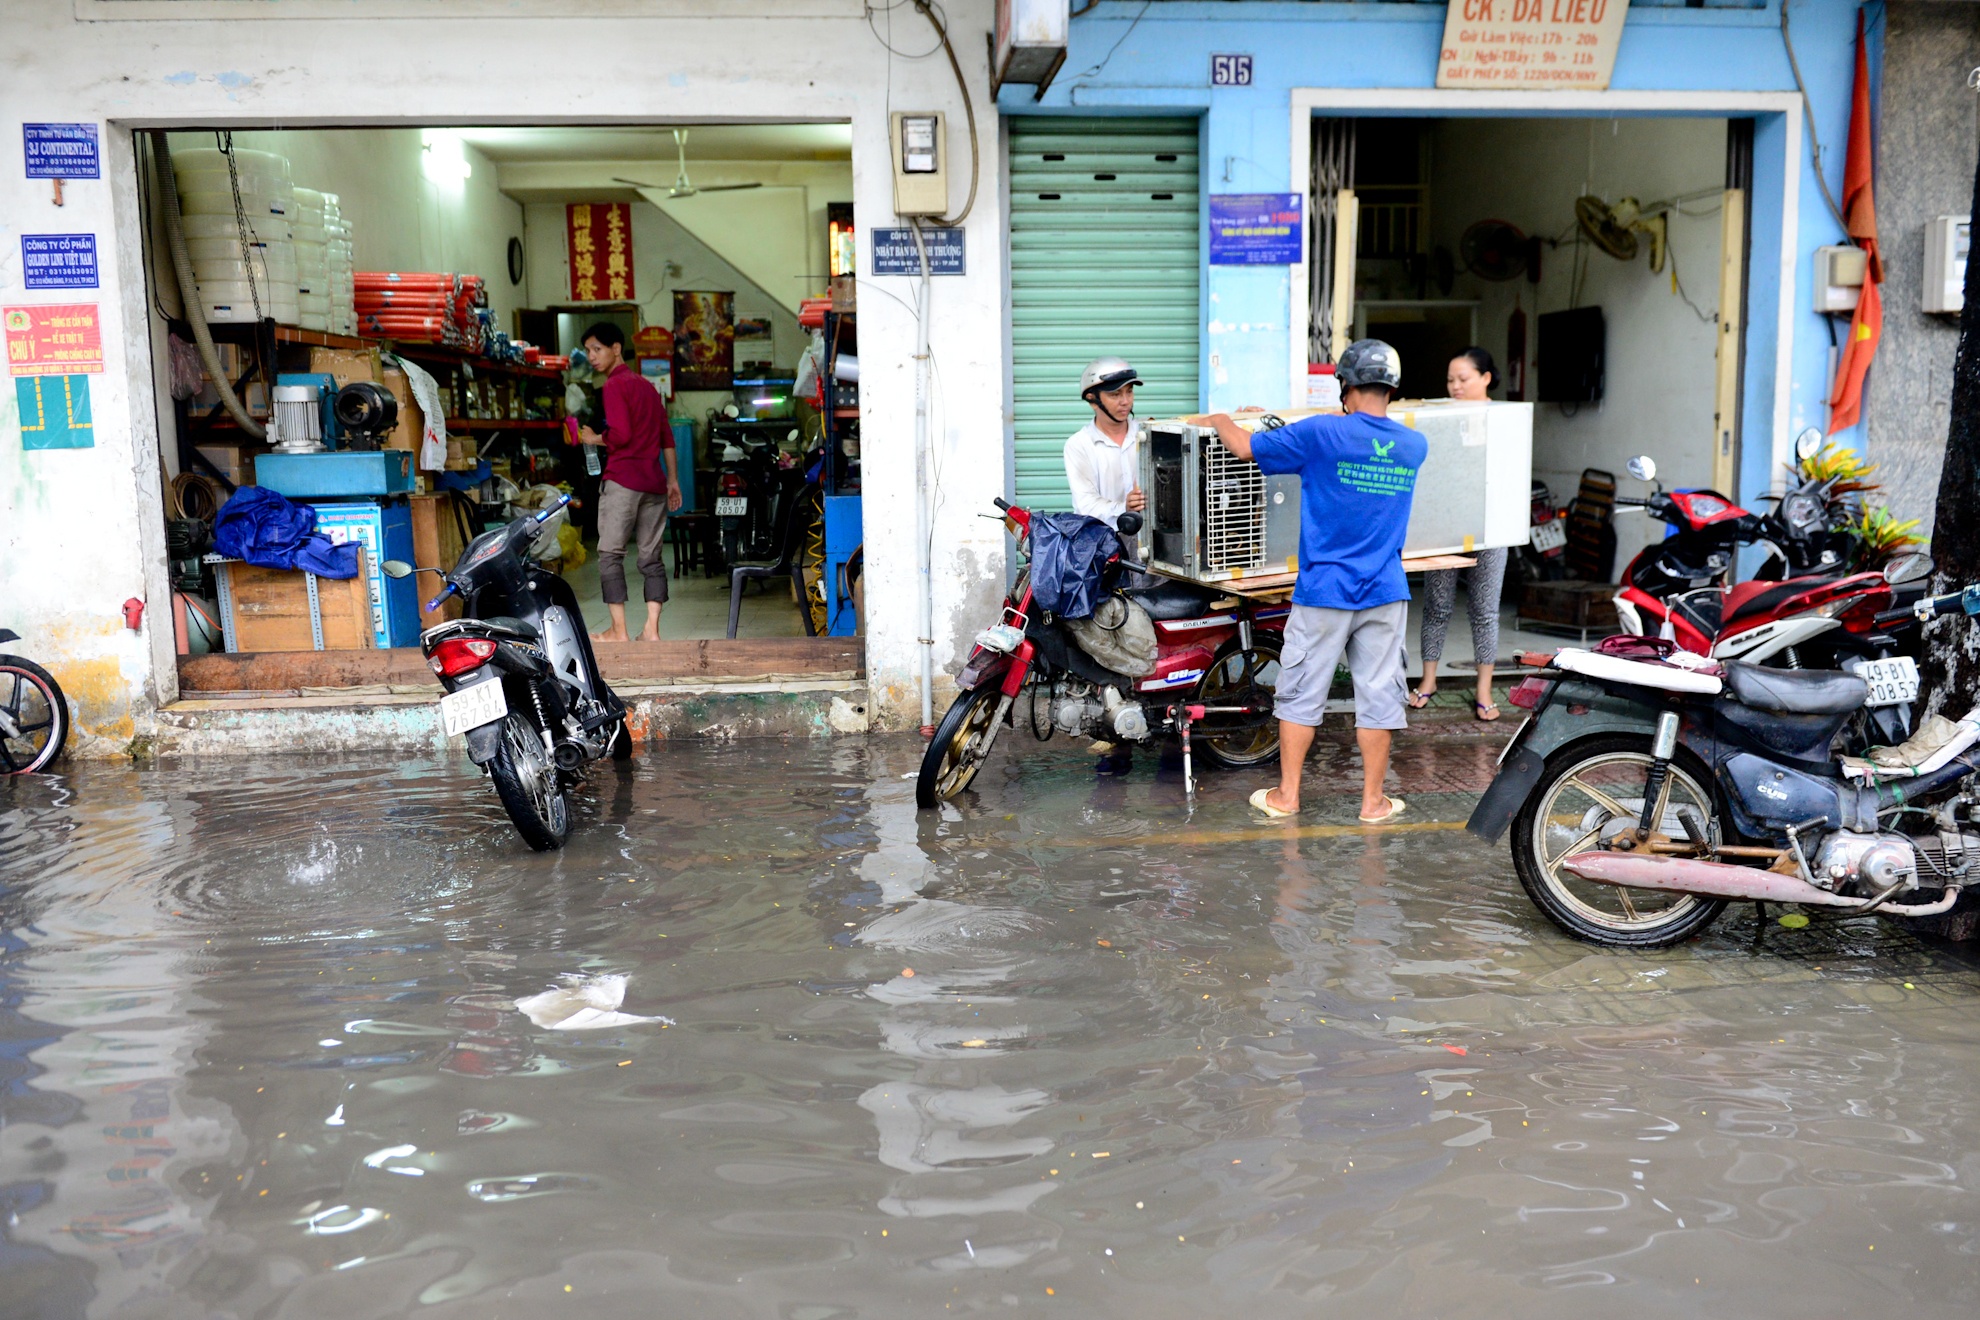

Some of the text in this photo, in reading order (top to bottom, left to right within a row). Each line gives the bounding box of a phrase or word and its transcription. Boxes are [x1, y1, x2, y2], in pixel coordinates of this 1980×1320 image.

[1463, 0, 1493, 22] CK
[1512, 0, 1543, 22] DA
[1576, 33, 1598, 46] 20h
[1543, 52, 1556, 64] 9h
[1572, 52, 1594, 64] 11h
[1216, 56, 1250, 84] 515
[28, 142, 94, 155] SJ CONTINENTAL
[26, 240, 48, 250] CÔNG
[49, 241, 58, 250] TY
[59, 237, 70, 250] CỔ
[27, 253, 50, 266] GOLDEN
[50, 253, 64, 266] LINE
[79, 253, 93, 265] NAM
[10, 334, 35, 360] CHÚ Ý
[458, 672, 478, 682] HONDA
[1867, 662, 1907, 681] 49-B1
[451, 684, 492, 712] 59-K1
[450, 700, 502, 732] 767.84
[1757, 785, 1788, 800] CUB
